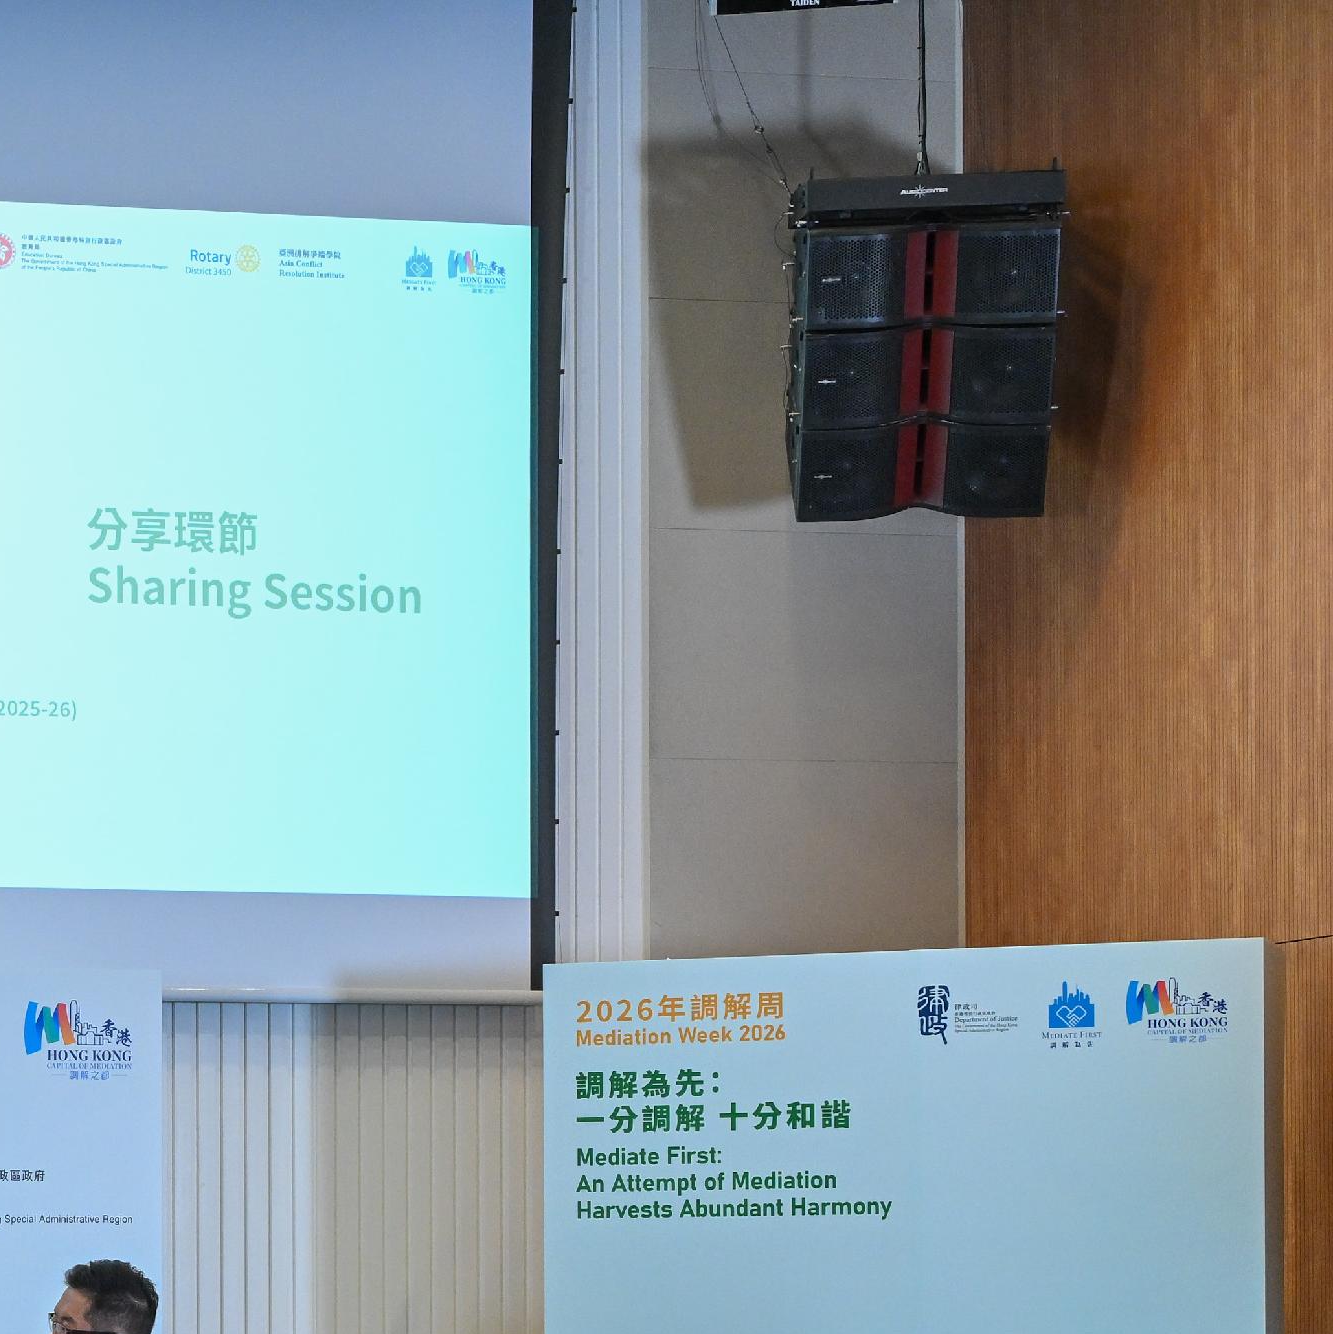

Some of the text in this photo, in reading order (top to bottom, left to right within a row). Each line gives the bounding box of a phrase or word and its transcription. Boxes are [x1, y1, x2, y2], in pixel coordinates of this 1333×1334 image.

[190, 249, 232, 265] Rotary
[185, 266, 212, 276] District
[88, 508, 257, 556] 分享環節
[88, 565, 421, 619] Sharing Session
[577, 992, 783, 1023] 2026年調解周
[1148, 1017, 1228, 1029] HONG KONG
[577, 1024, 786, 1047] Mediation Week 2026
[48, 1050, 132, 1061] HONG KONG
[576, 1069, 718, 1099] 調解為先：
[577, 1100, 851, 1133] 一分調解 十分和諧
[577, 1146, 721, 1166] Mediate First:
[576, 1171, 836, 1196] An Attempt of Mediation
[5, 1215, 36, 1225] Special
[39, 1215, 100, 1223] Administrative
[103, 1215, 133, 1225] Region
[578, 1197, 892, 1220] Harvests Abundant Harmony
